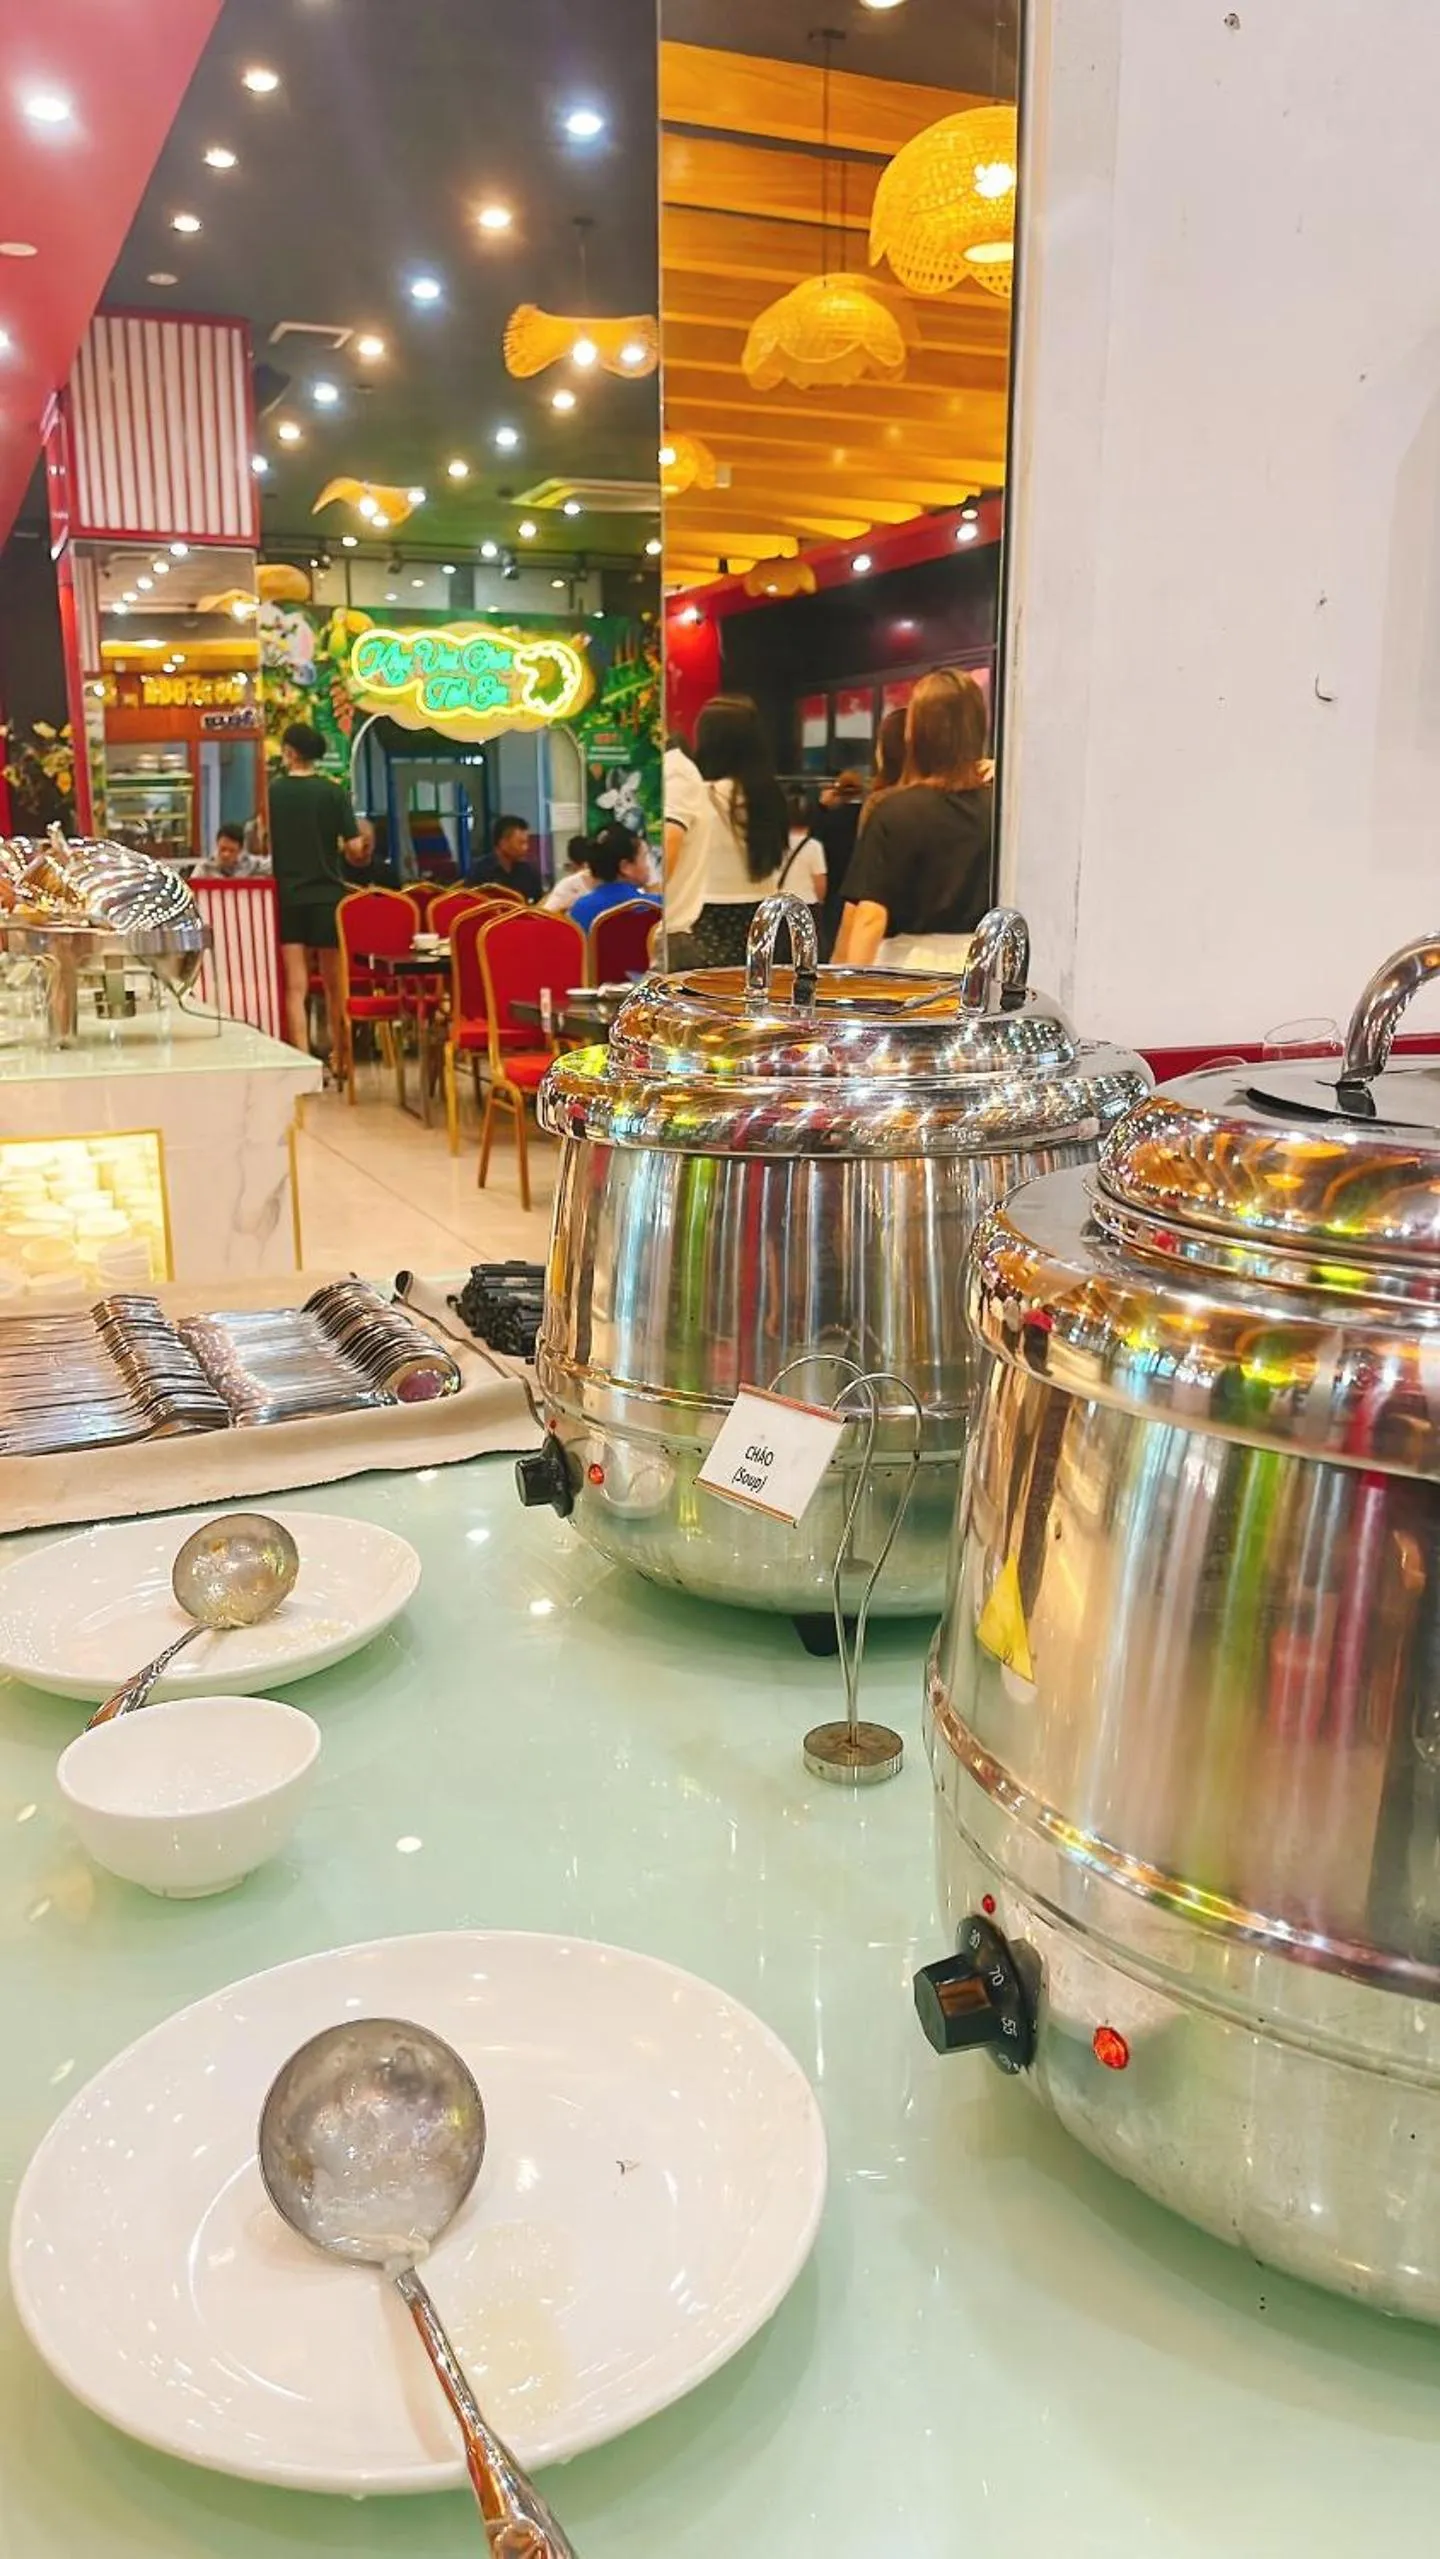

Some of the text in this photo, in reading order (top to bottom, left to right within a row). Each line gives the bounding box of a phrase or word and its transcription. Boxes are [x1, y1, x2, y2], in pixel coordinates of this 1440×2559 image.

[745, 1446, 774, 1467] CHÁO
[732, 1466, 768, 1493] (Soup)
[989, 1964, 1004, 1986] 70
[1002, 2016, 1017, 2037] 55
